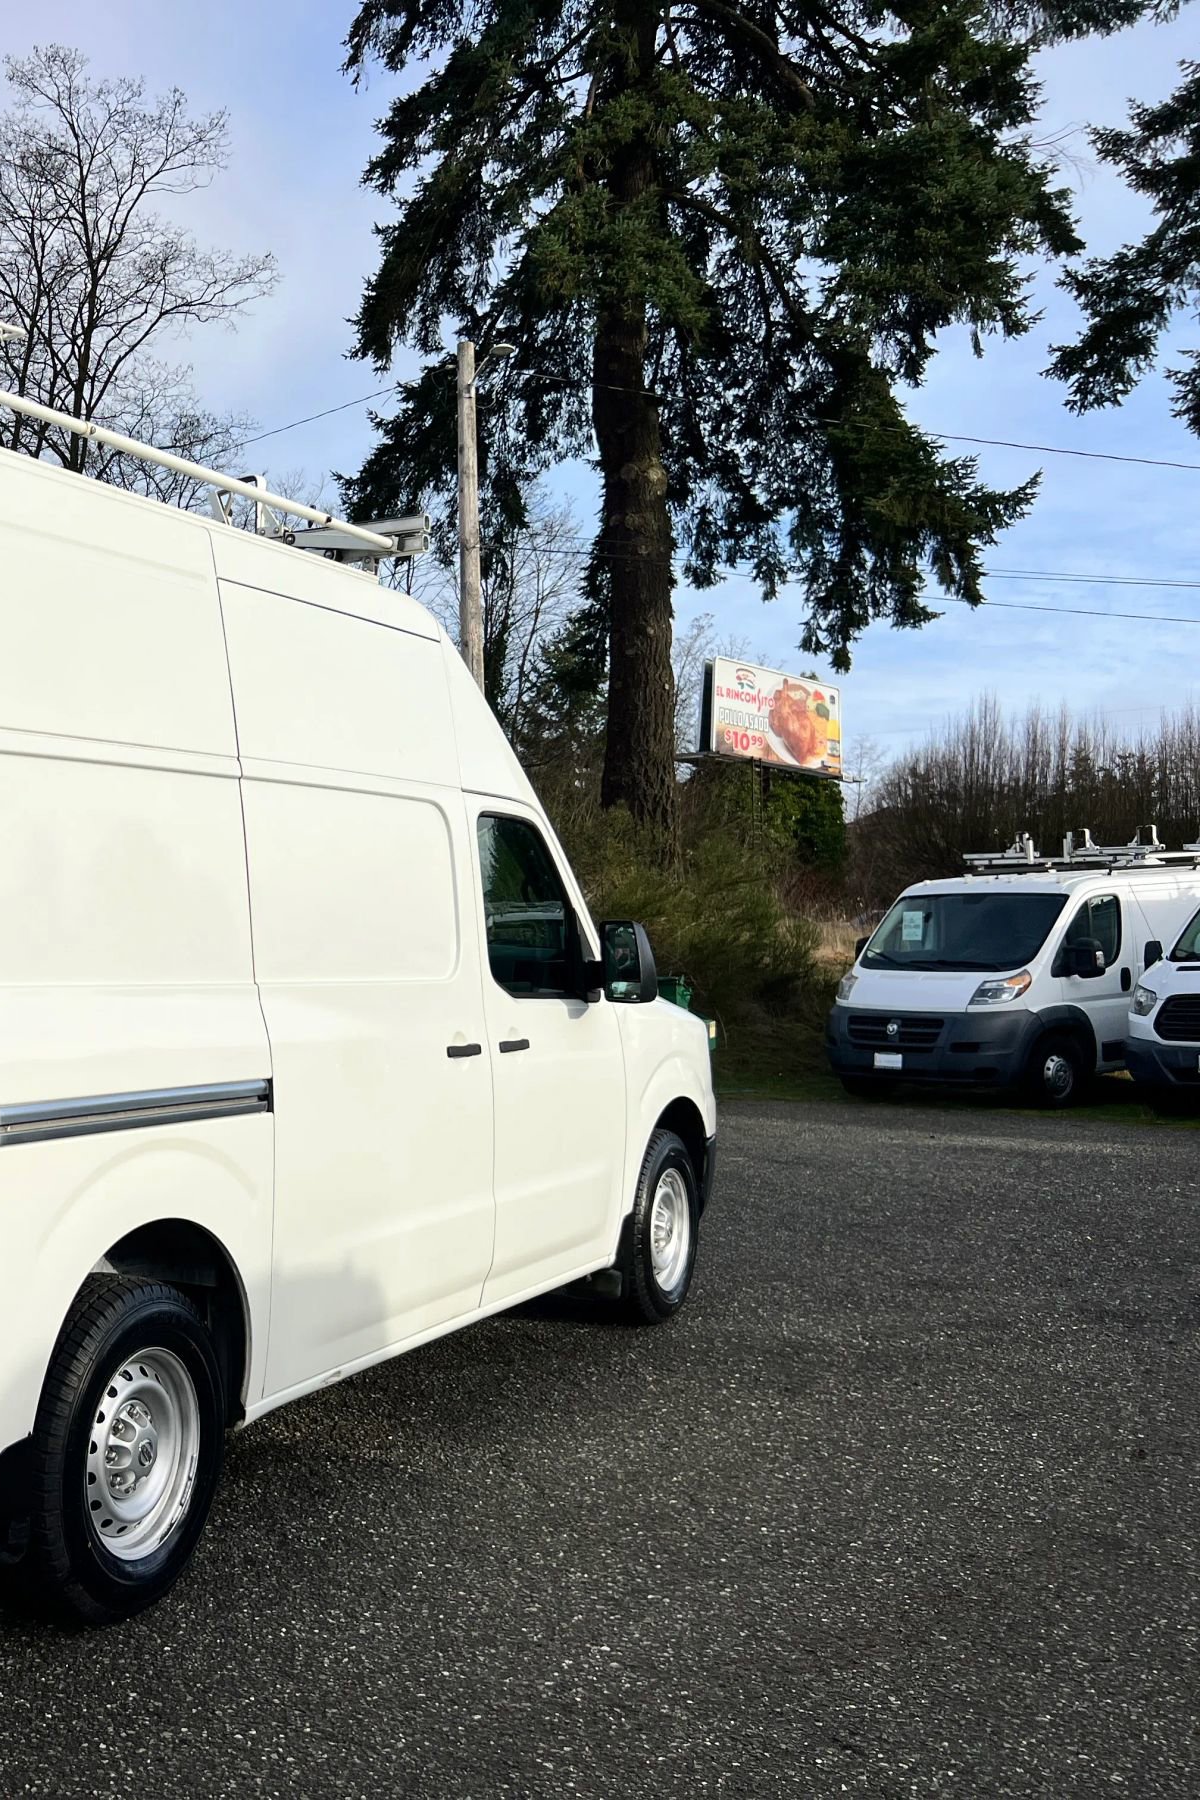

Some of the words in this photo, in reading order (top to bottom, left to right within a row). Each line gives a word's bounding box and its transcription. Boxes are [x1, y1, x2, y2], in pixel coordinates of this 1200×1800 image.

[716, 685, 725, 698] EL
[719, 707, 744, 727] POLLO
[745, 713, 769, 733] ASADO
